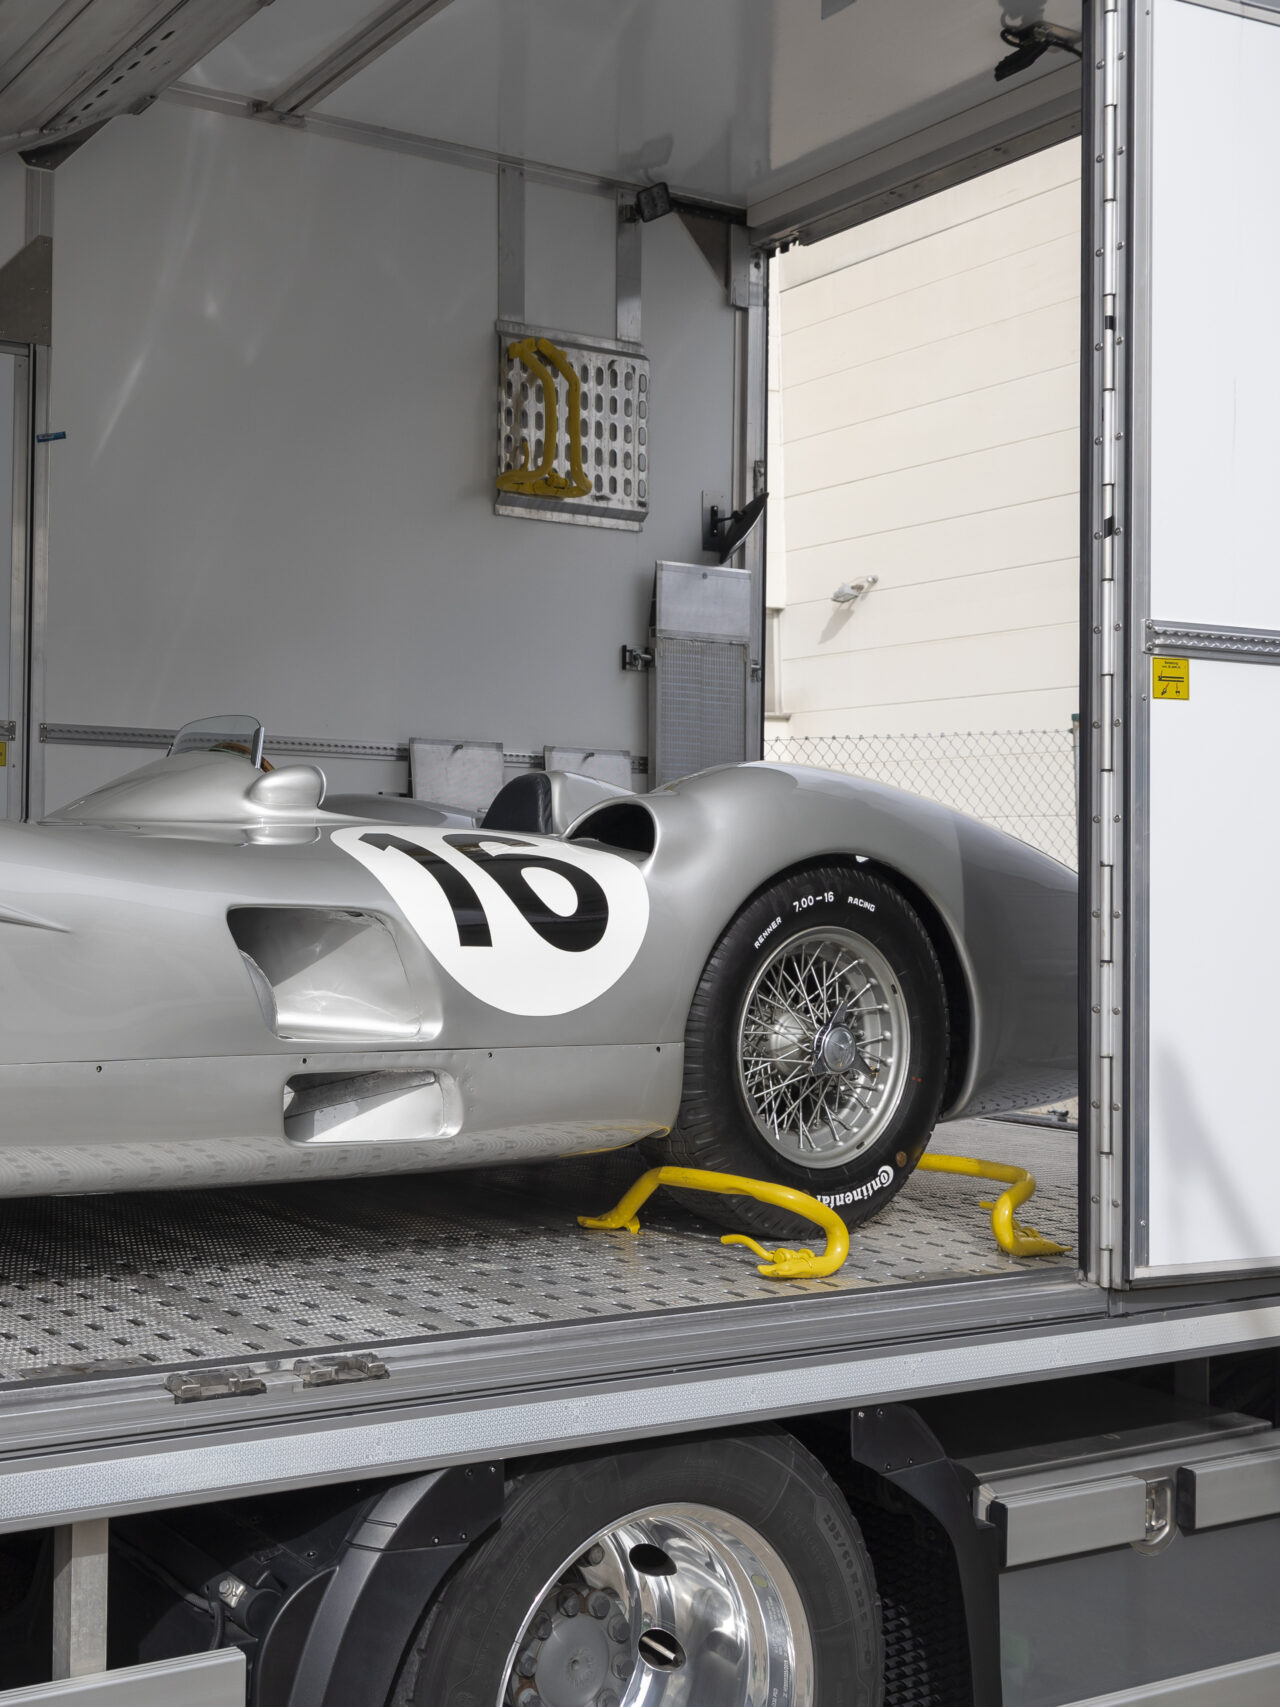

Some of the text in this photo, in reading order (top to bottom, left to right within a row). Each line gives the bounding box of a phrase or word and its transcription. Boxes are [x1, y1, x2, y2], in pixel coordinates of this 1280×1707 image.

[358, 833, 609, 952] 16
[753, 916, 782, 949] RENNER
[847, 896, 876, 912] RACING
